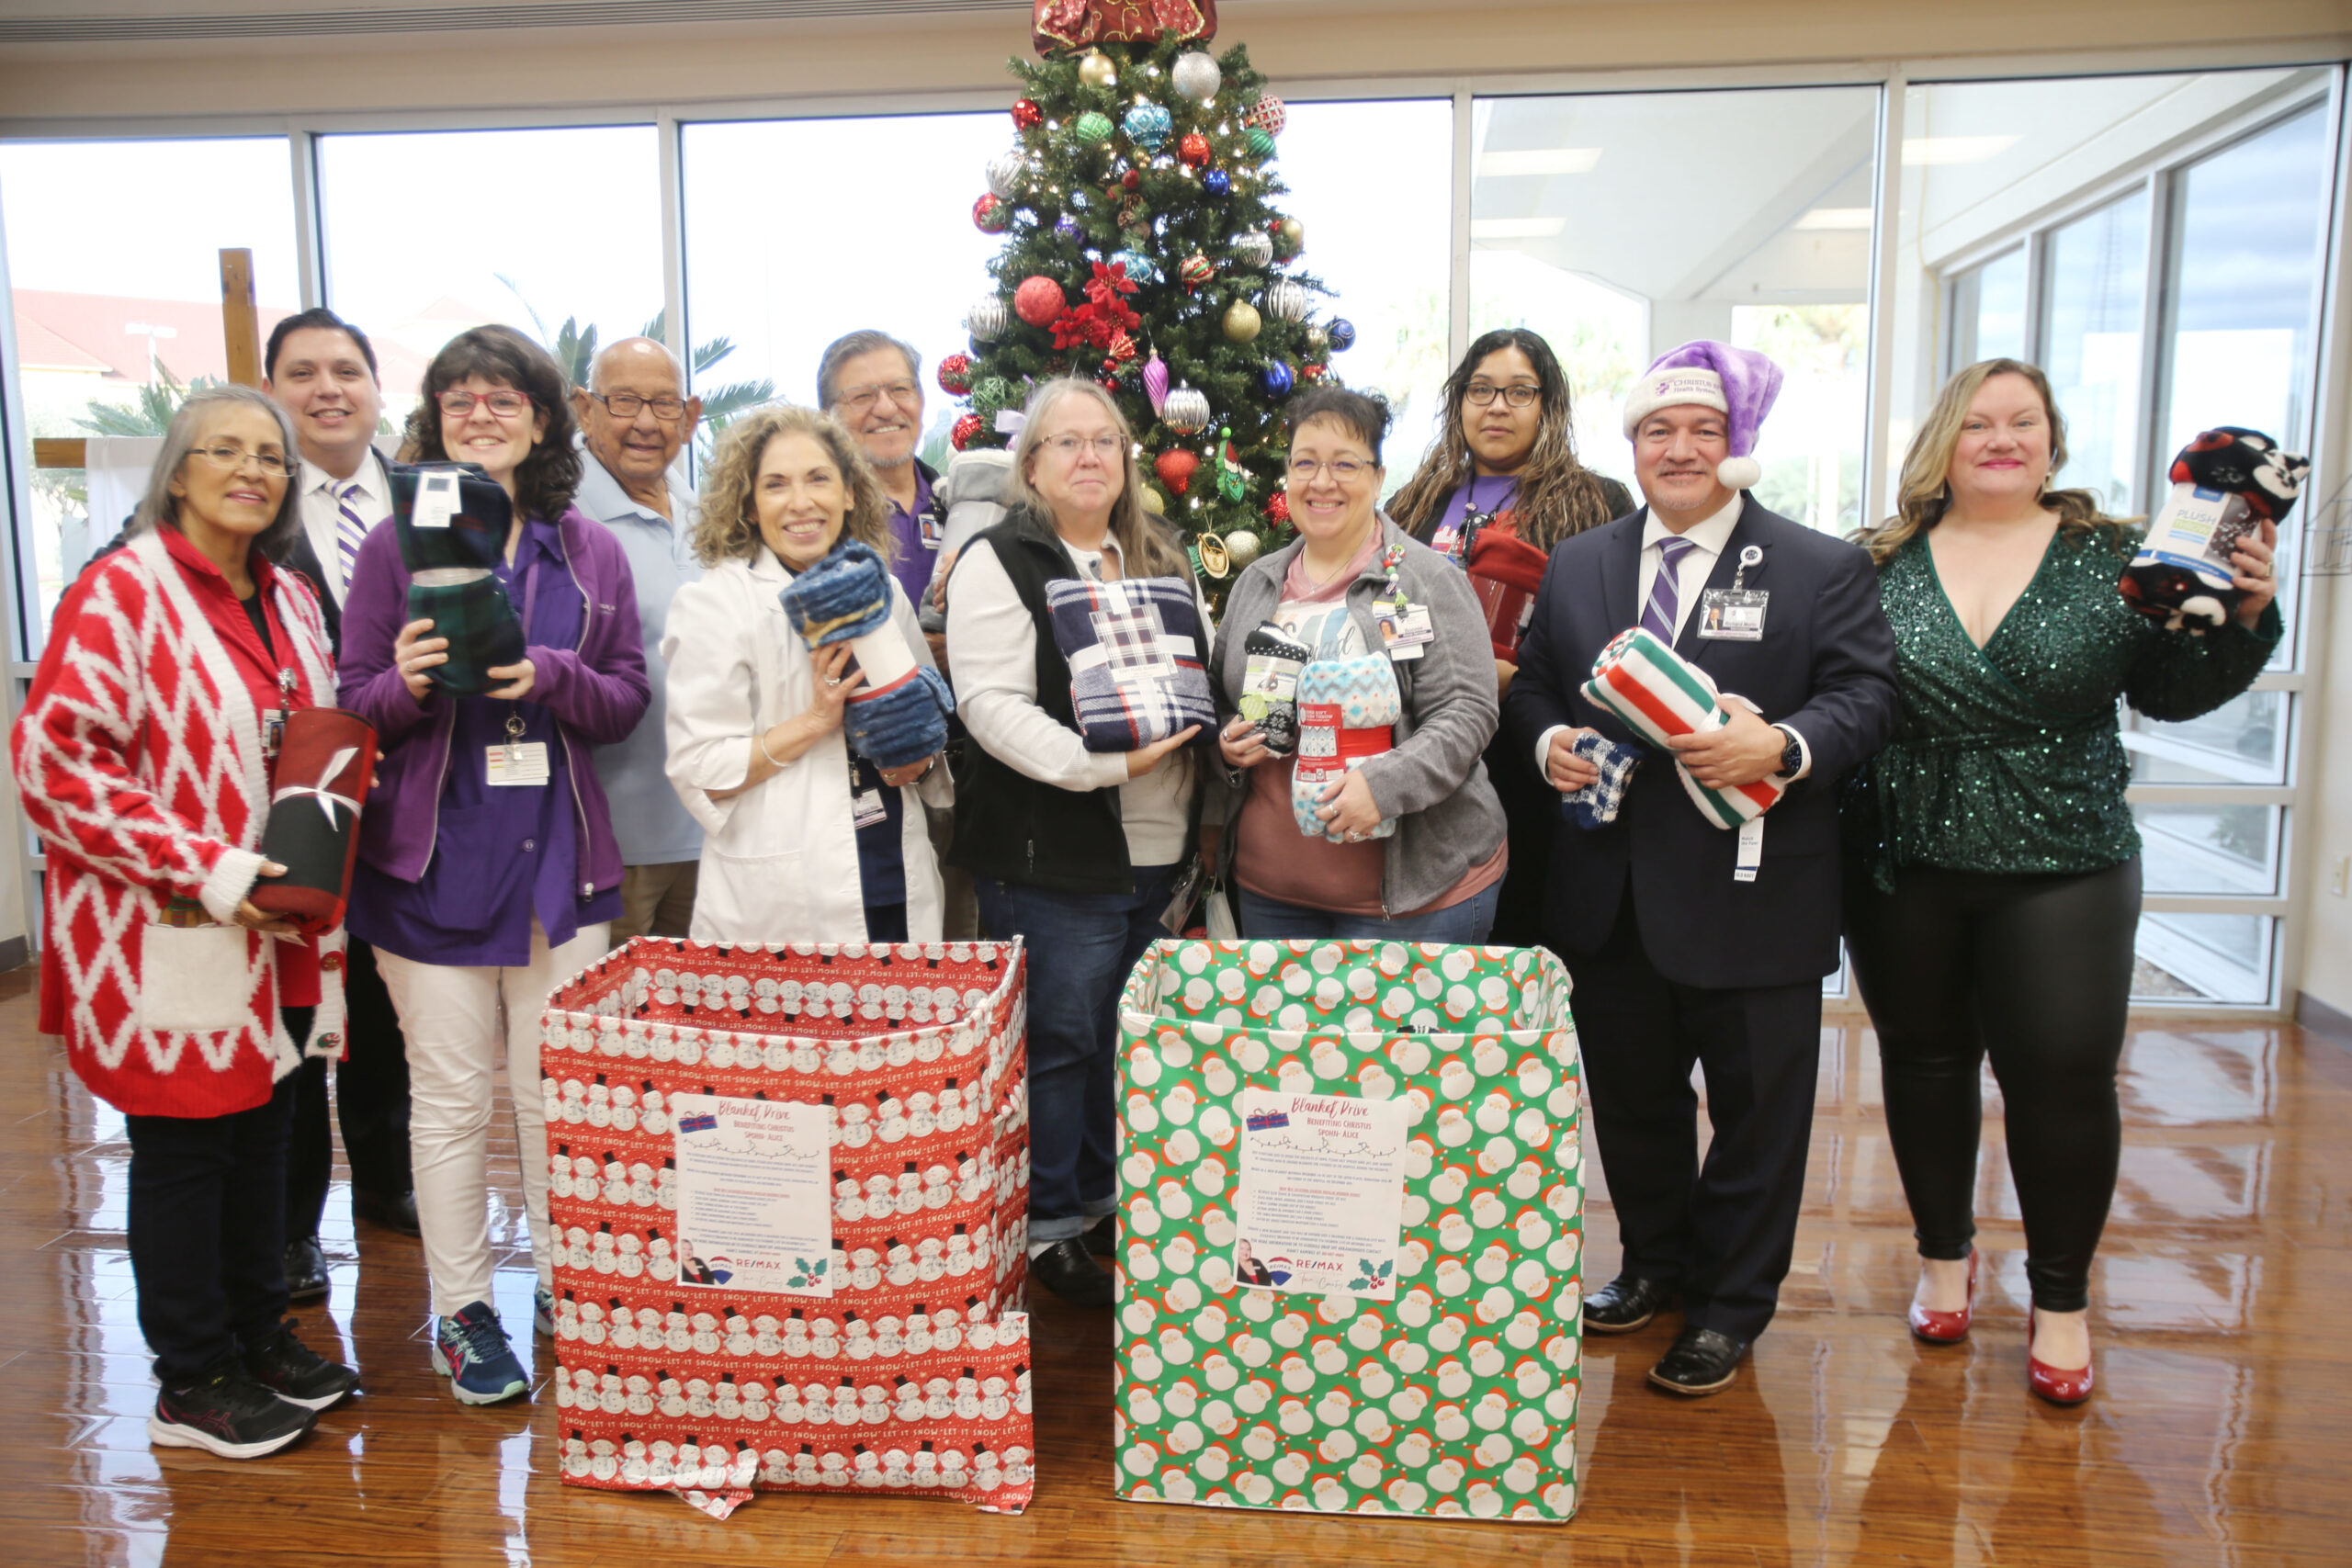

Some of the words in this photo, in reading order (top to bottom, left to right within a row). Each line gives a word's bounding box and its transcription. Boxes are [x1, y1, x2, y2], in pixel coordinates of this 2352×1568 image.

[2177, 509, 2217, 525] PLUSH
[573, 1059, 594, 1067] SNOW
[625, 1065, 647, 1073] SNOW
[735, 1076, 759, 1084] SNOW
[856, 1078, 881, 1087] SNOW
[888, 1074, 901, 1083] LET
[919, 1066, 943, 1077] SNOW
[949, 1062, 962, 1073] LET
[965, 1059, 971, 1069] IT
[718, 1100, 762, 1122] Blanket
[763, 1106, 791, 1120] Drive
[1291, 1097, 1338, 1118] Blanket
[1340, 1102, 1369, 1117] Drive
[604, 1138, 626, 1146] SNOW
[896, 1148, 921, 1160] SNOW
[928, 1143, 940, 1153] LET
[944, 1141, 951, 1149] IT
[956, 1134, 976, 1147] SNOW
[576, 1207, 599, 1216] SNOW
[631, 1213, 654, 1222] SNOW
[866, 1224, 891, 1234] SNOW
[898, 1221, 910, 1230] LET
[928, 1211, 952, 1224] SNOW
[957, 1208, 969, 1218] LET
[736, 1258, 781, 1270] RE/MAX
[1296, 1259, 1344, 1272] RE/MAX
[558, 1276, 578, 1286] SNOW
[610, 1284, 632, 1293] SNOW
[665, 1289, 688, 1299] SNOW
[905, 1291, 930, 1301] SNOW
[936, 1288, 949, 1297] LET
[966, 1280, 985, 1290] SNOW
[584, 1349, 606, 1358] SNOW
[755, 1362, 779, 1370] SNOW
[906, 1360, 919, 1368] LET
[937, 1355, 961, 1364] SNOW
[967, 1355, 979, 1363] LET
[996, 1352, 1019, 1361] SNOW
[565, 1417, 586, 1426] SNOW
[735, 1427, 759, 1435] SNOW
[974, 1428, 997, 1436] SNOW
[1002, 1492, 1025, 1500] SNOW
